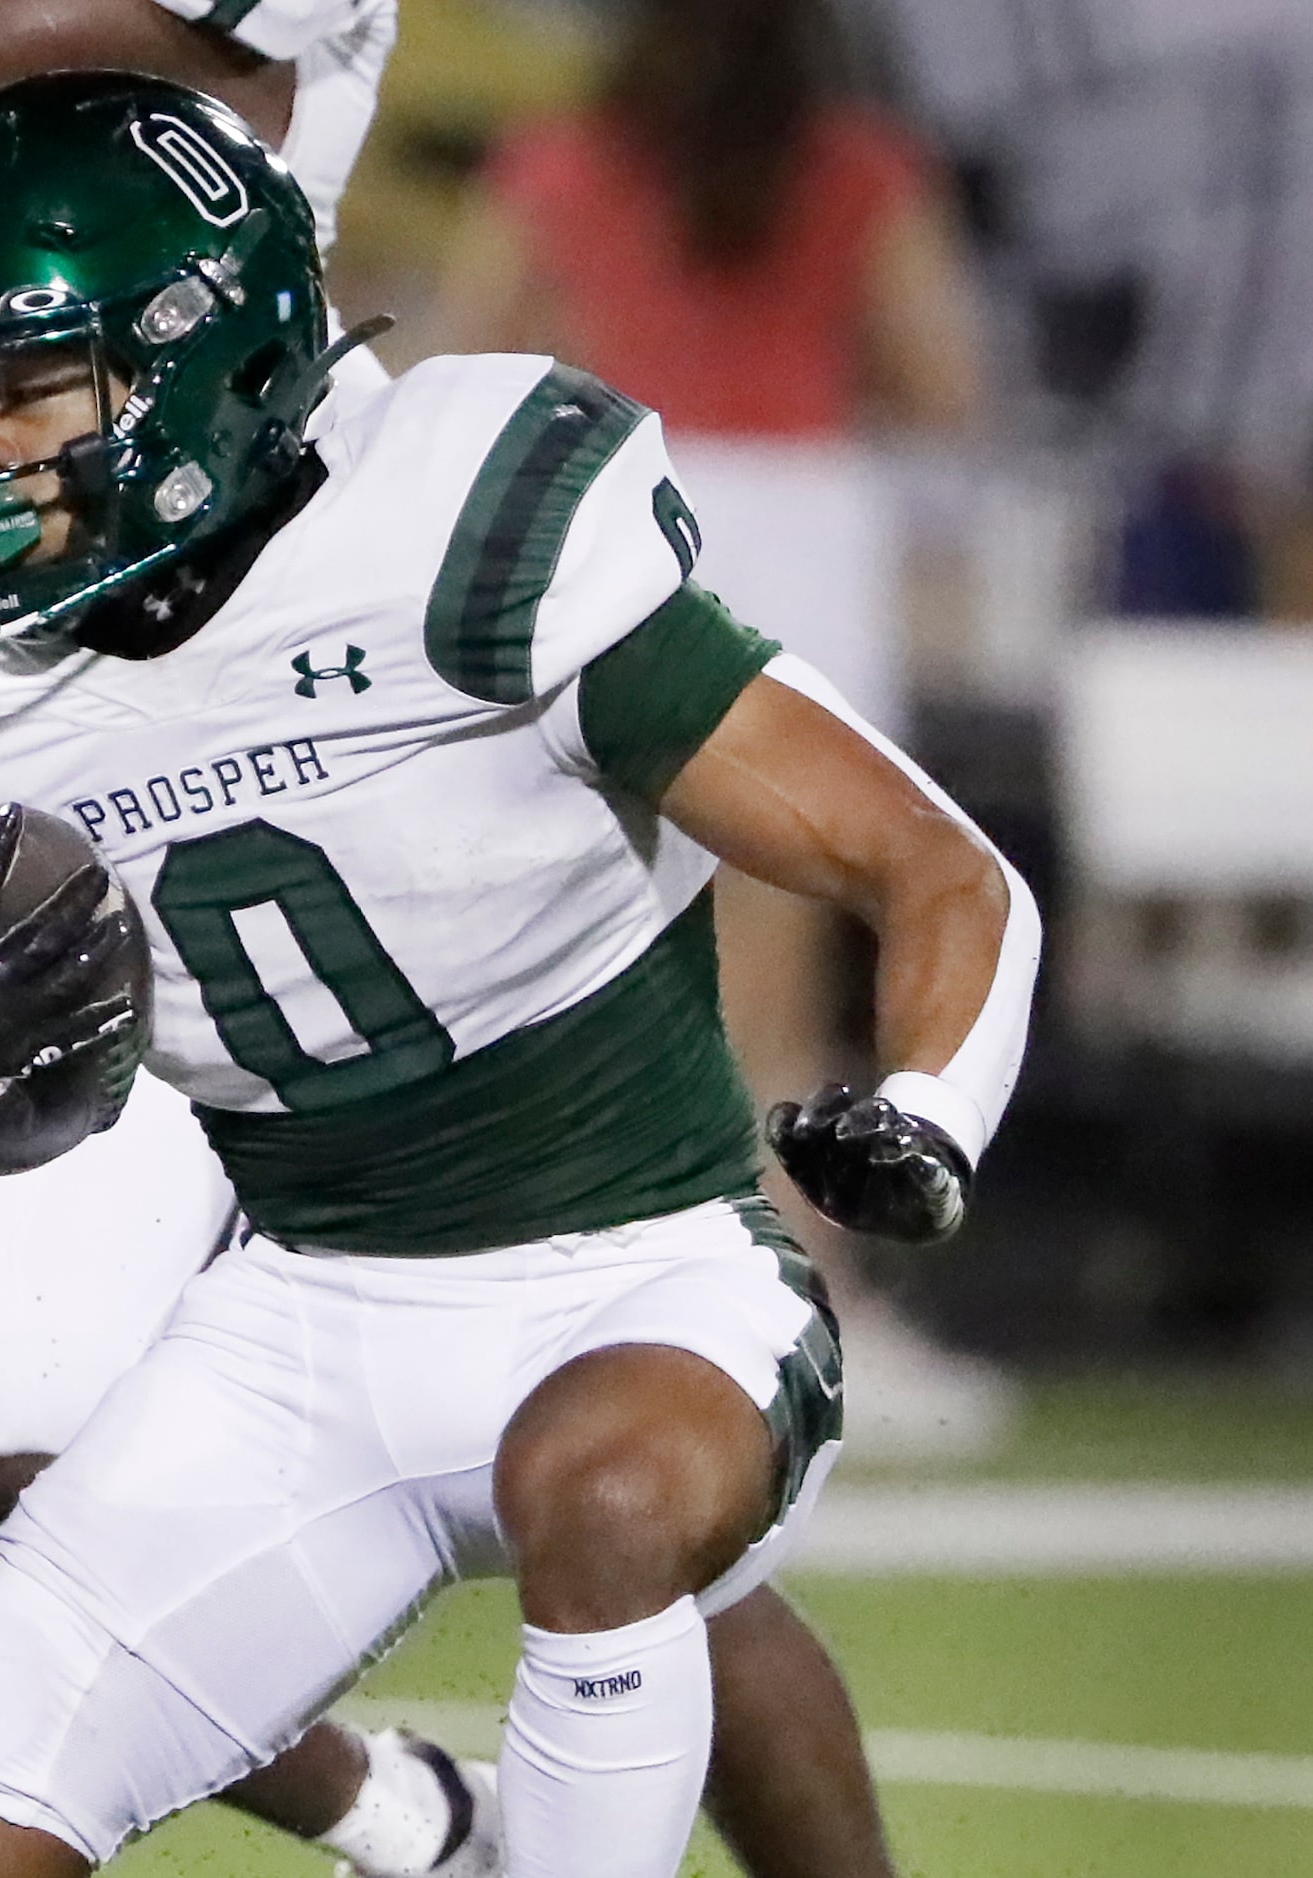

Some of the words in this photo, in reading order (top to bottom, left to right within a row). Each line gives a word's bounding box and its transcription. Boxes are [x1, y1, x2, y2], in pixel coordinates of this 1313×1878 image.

[73, 737, 329, 843] PROSPER
[150, 817, 457, 1113] 0
[574, 1669, 642, 1698] NXTRND
